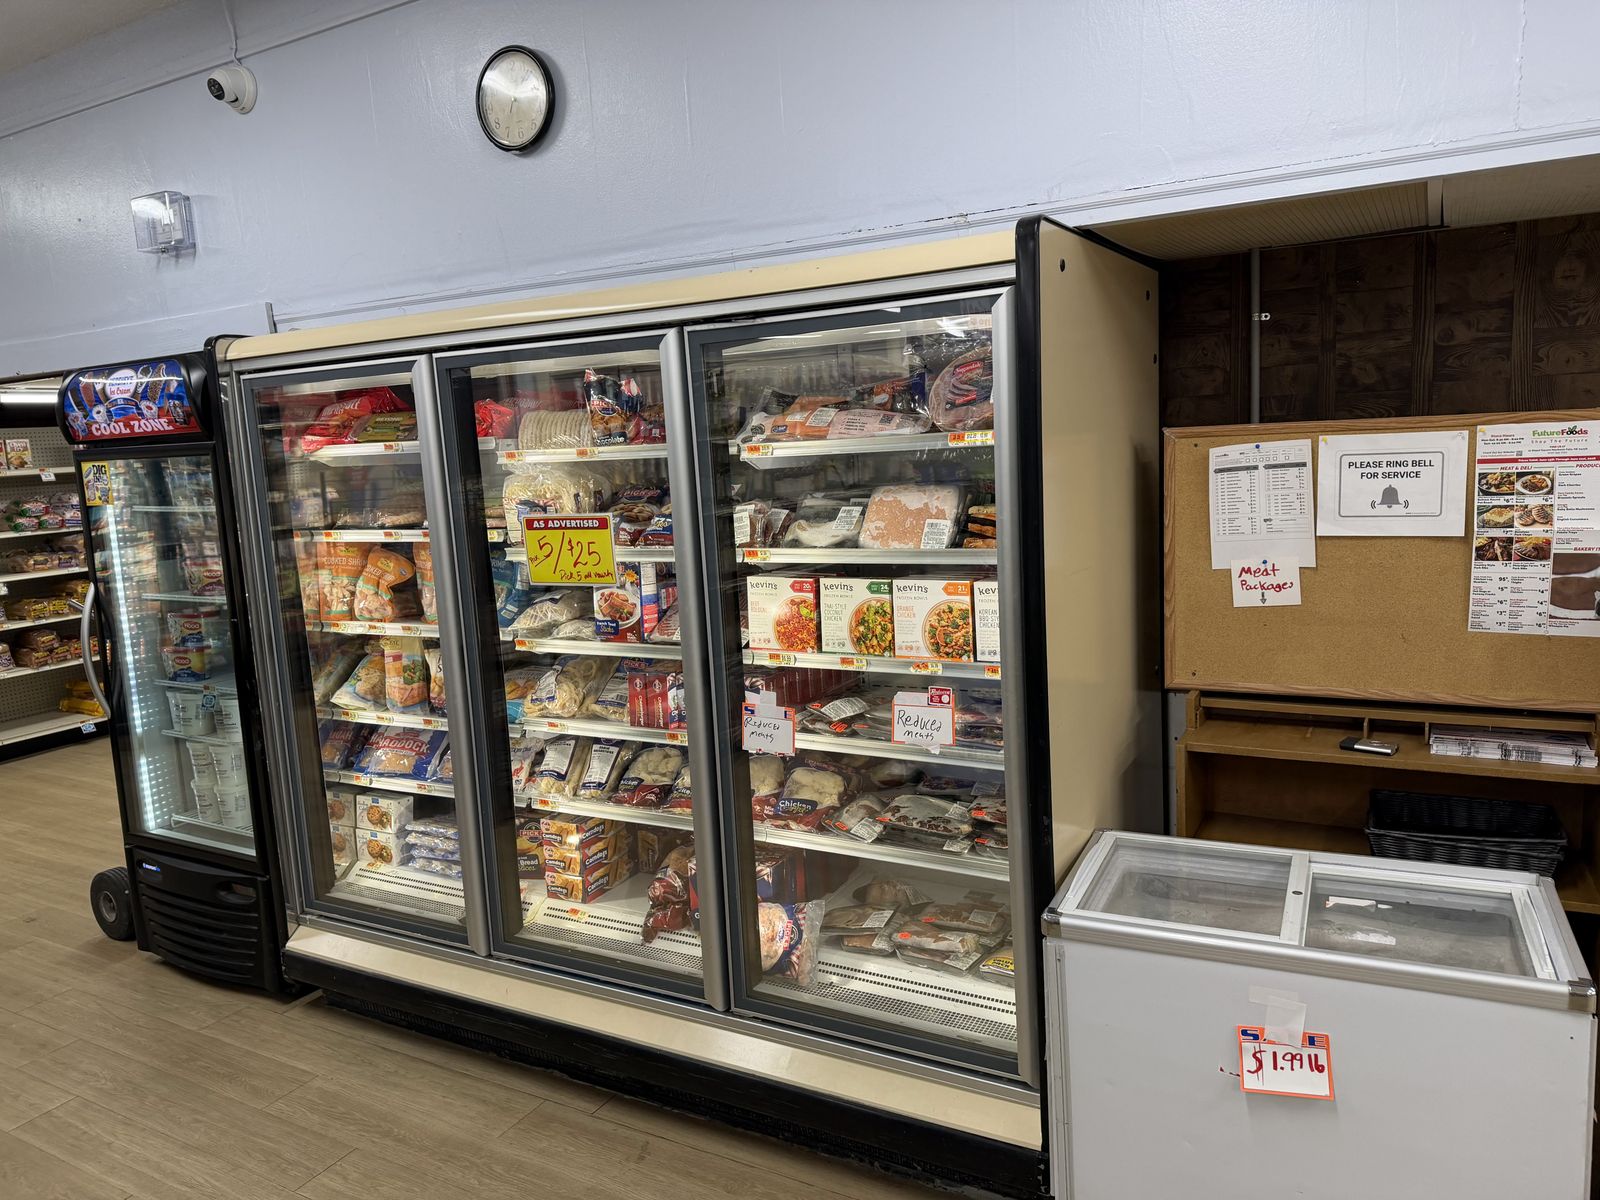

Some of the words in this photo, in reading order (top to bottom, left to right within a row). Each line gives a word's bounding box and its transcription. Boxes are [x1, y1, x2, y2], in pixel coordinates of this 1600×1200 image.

[92, 422, 130, 436] COOL
[131, 418, 174, 433] ZONE
[1348, 460, 1383, 469] PLEASE
[92, 464, 107, 475] DIG
[1381, 471, 1421, 479] SERVICE
[1238, 563, 1280, 578] Meat
[750, 581, 778, 590] kevin's
[823, 582, 854, 591] kevin's
[896, 584, 929, 593] kevin's
[1240, 580, 1294, 592] Packages
[978, 587, 999, 595] kev
[897, 709, 942, 732] Reduced
[780, 800, 811, 809] Chicken
